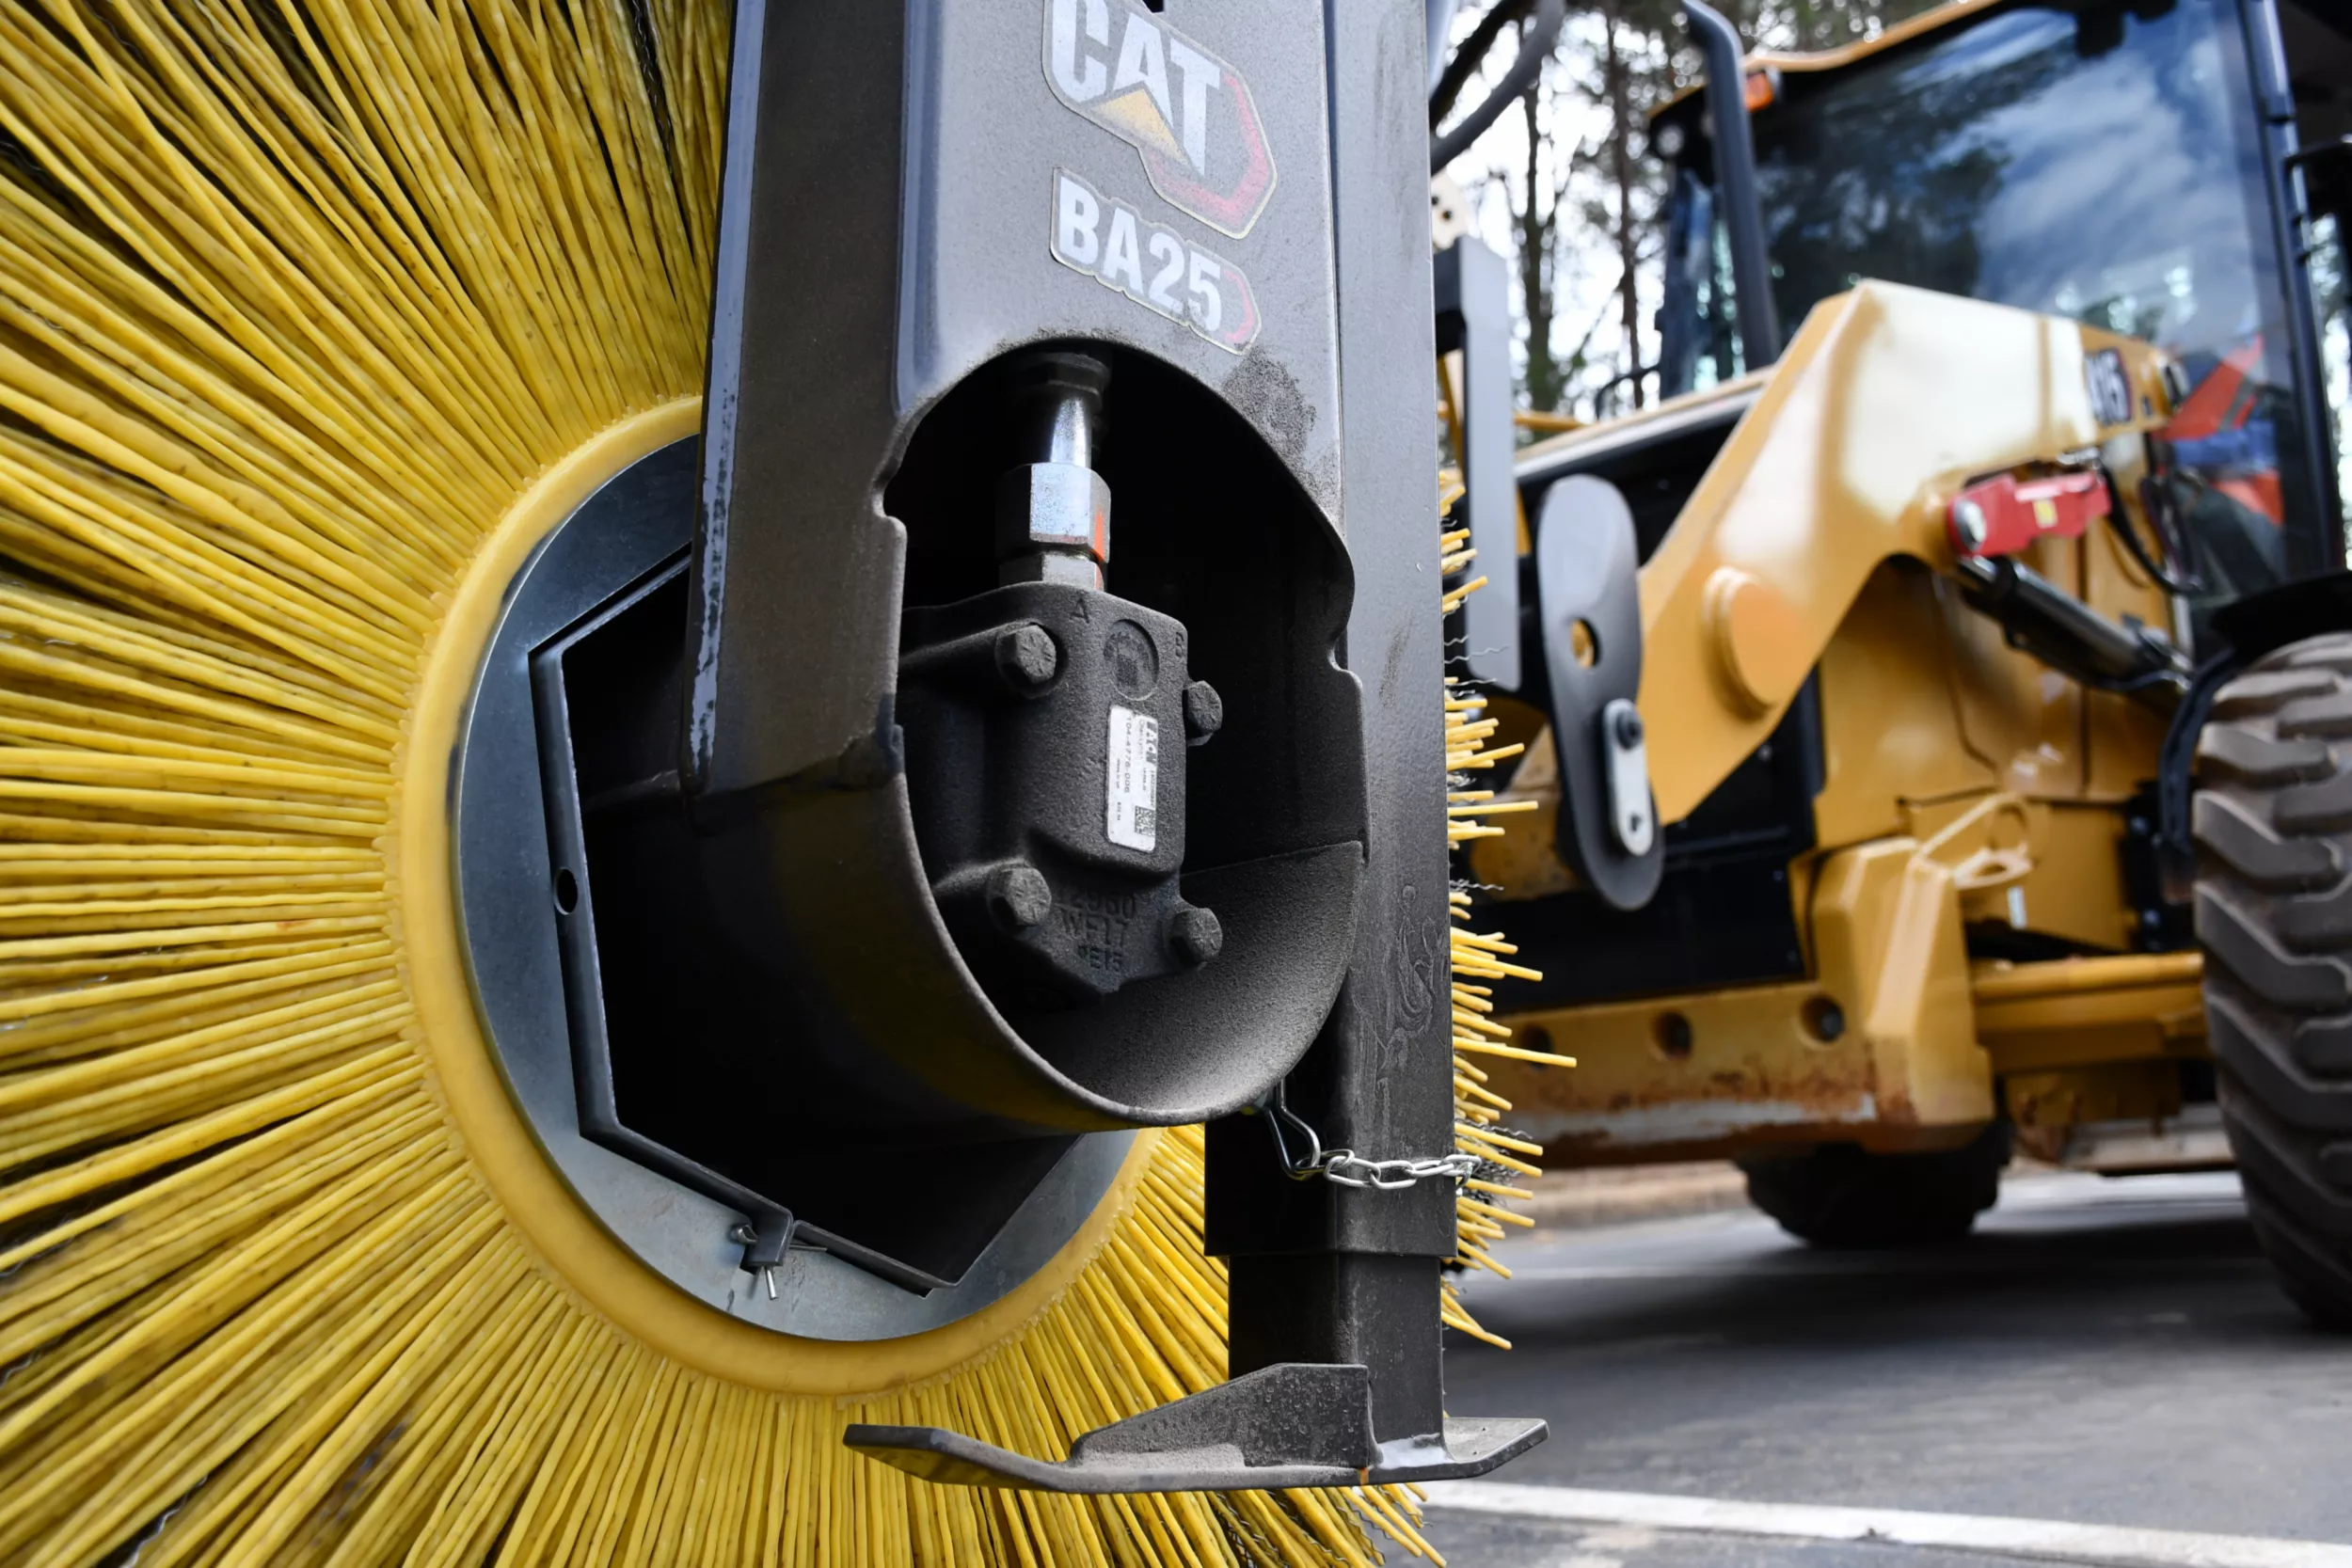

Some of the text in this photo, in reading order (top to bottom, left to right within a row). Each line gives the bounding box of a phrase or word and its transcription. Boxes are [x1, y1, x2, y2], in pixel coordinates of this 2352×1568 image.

[1052, 0, 1221, 177] CAT
[1058, 176, 1222, 331] BA25
[1146, 721, 1158, 767] EATON
